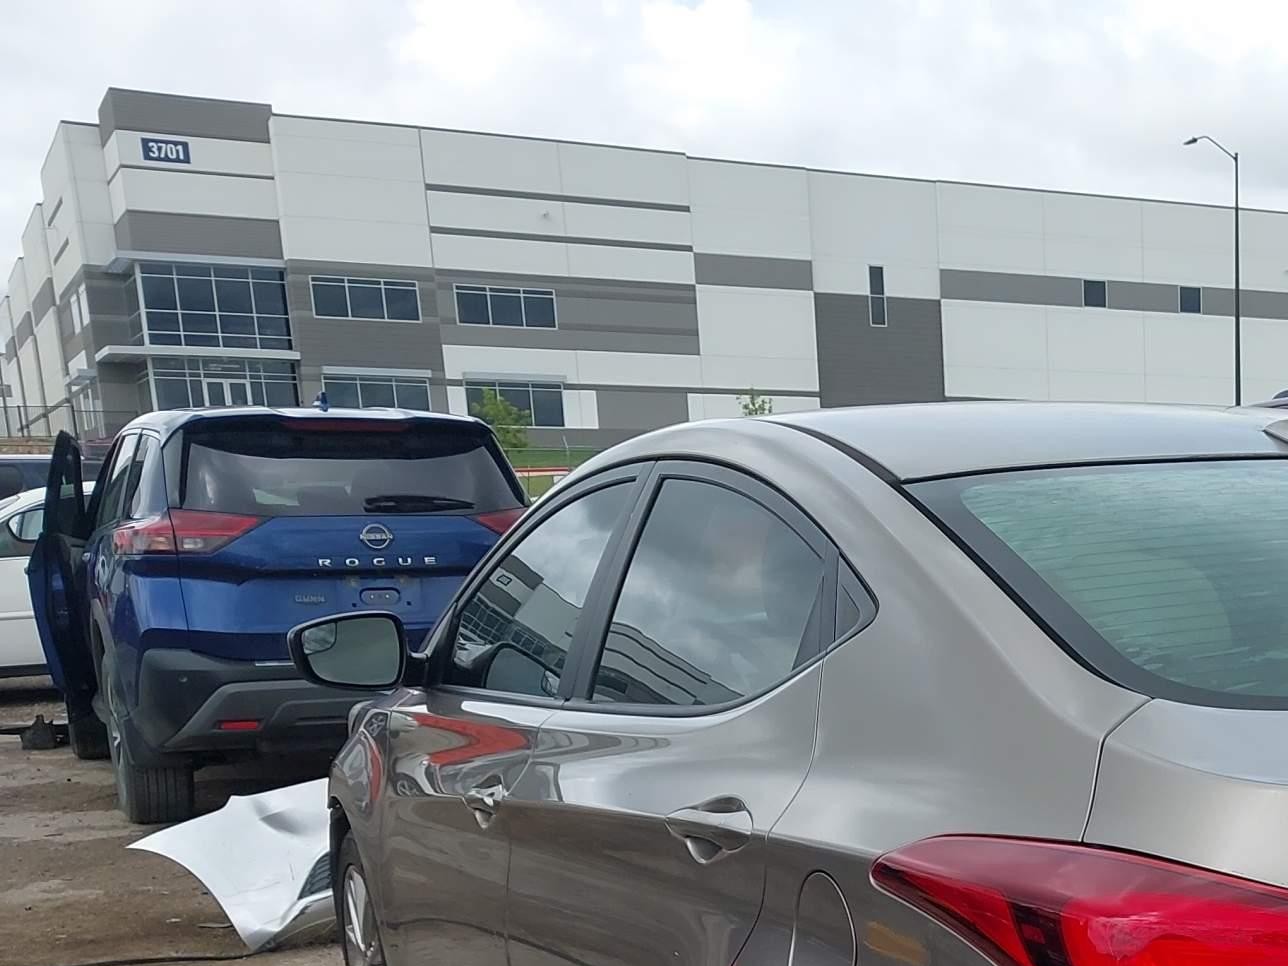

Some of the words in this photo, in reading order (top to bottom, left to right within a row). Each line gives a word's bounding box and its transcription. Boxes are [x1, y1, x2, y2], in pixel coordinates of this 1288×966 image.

[148, 142, 184, 160] 3701
[360, 532, 393, 540] NISSAN
[318, 556, 439, 567] ROGUE
